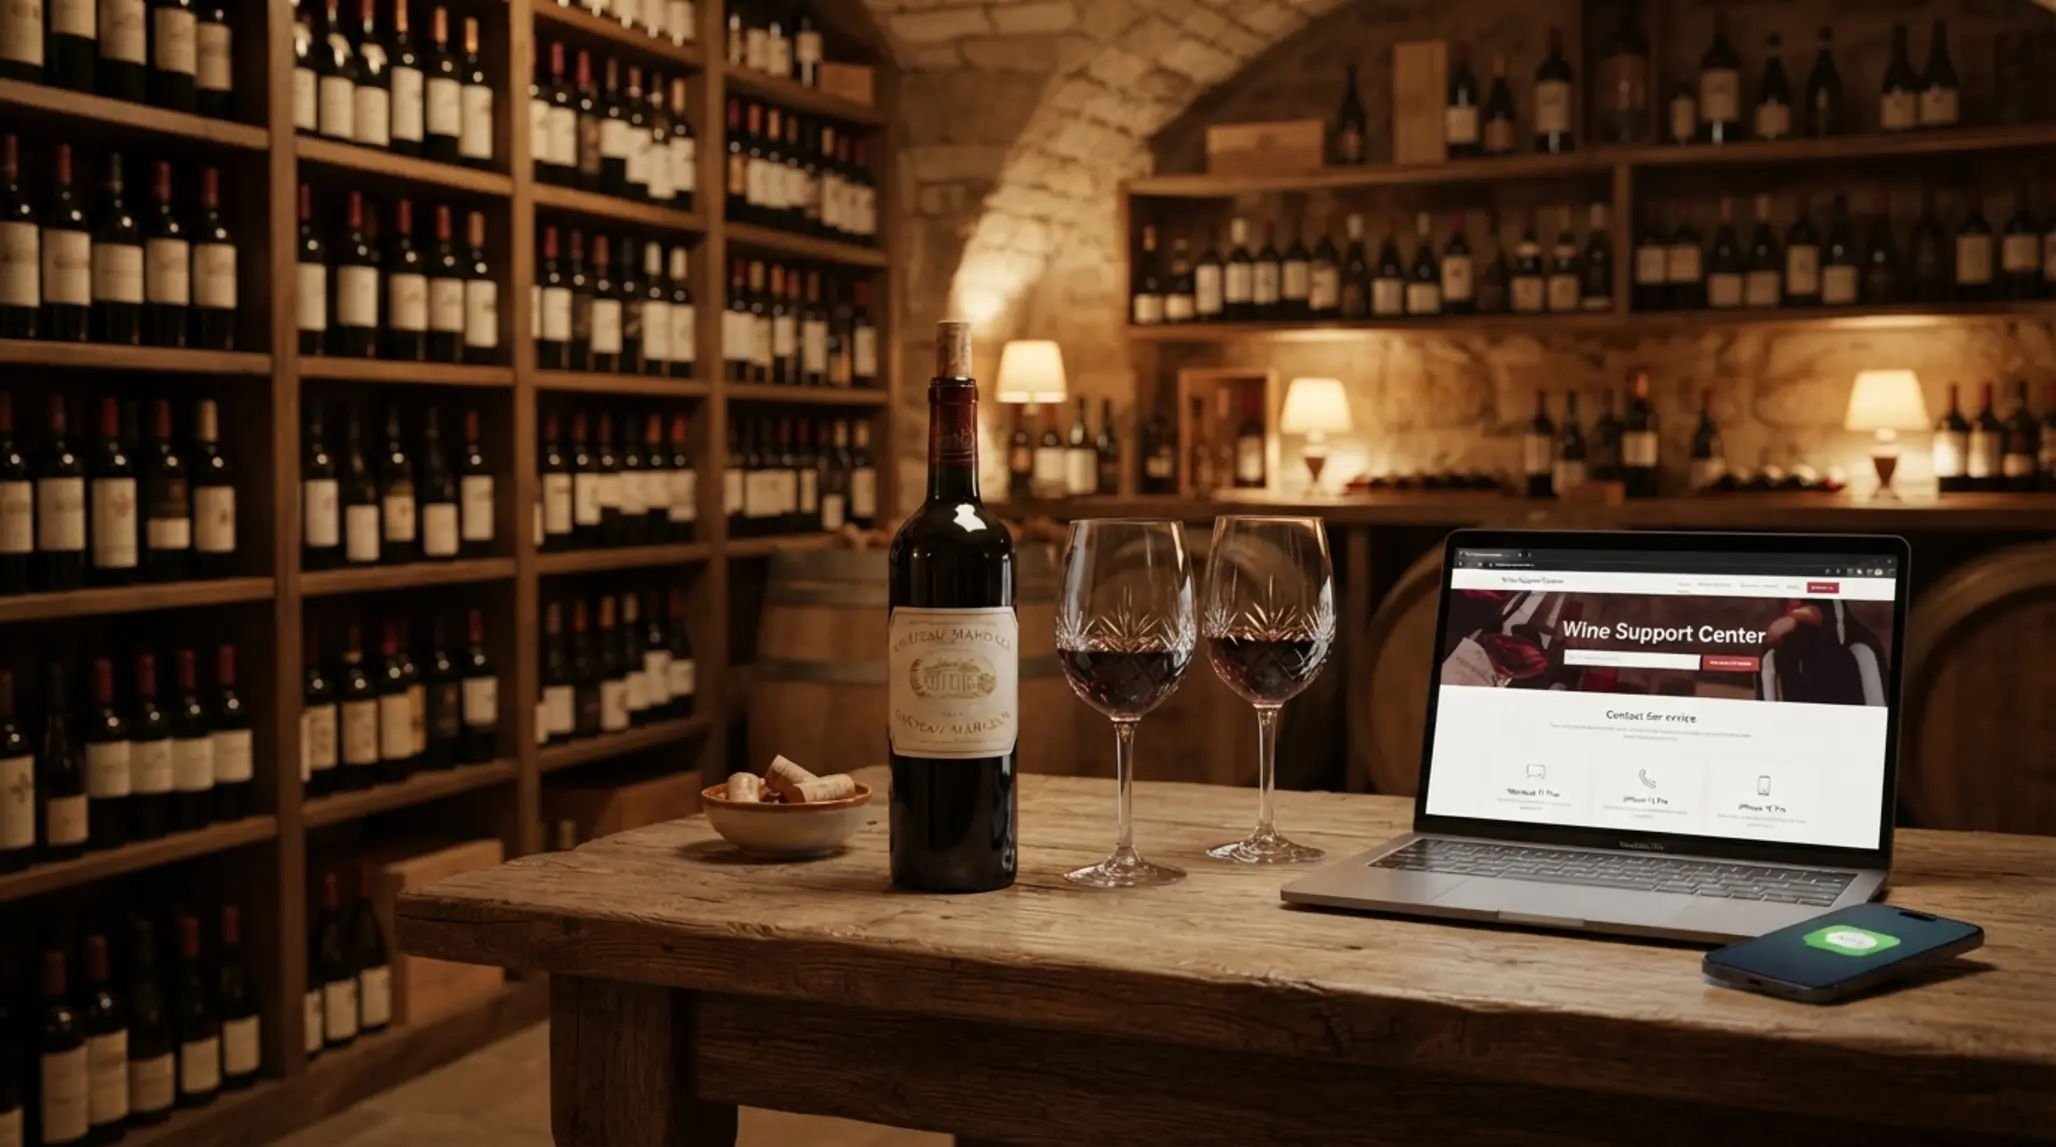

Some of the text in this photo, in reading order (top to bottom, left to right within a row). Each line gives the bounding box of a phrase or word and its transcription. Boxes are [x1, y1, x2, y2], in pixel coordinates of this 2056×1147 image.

[1562, 620, 1767, 645] Wine Support Center
[1606, 709, 1644, 721] Contact
